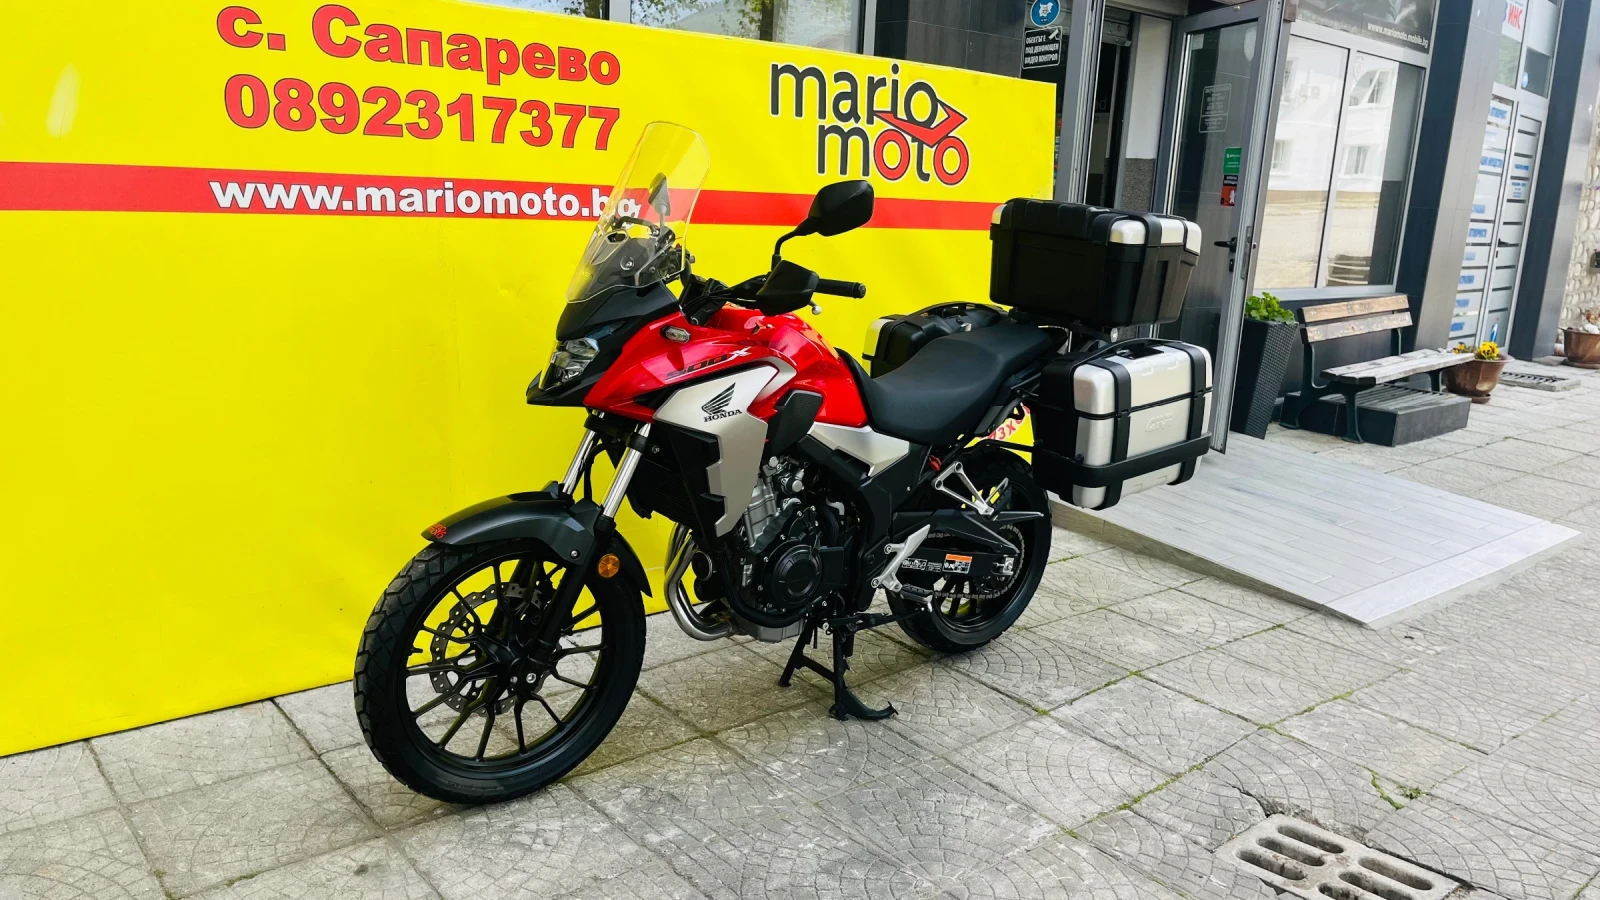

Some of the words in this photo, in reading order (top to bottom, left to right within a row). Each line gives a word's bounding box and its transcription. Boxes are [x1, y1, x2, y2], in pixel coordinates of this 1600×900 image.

[216, 5, 286, 52] с.
[312, 4, 621, 86] Сапарево
[225, 73, 621, 151] 0892317377
[770, 63, 939, 129] mario
[817, 120, 970, 186] moto
[704, 409, 742, 422] HONDA
